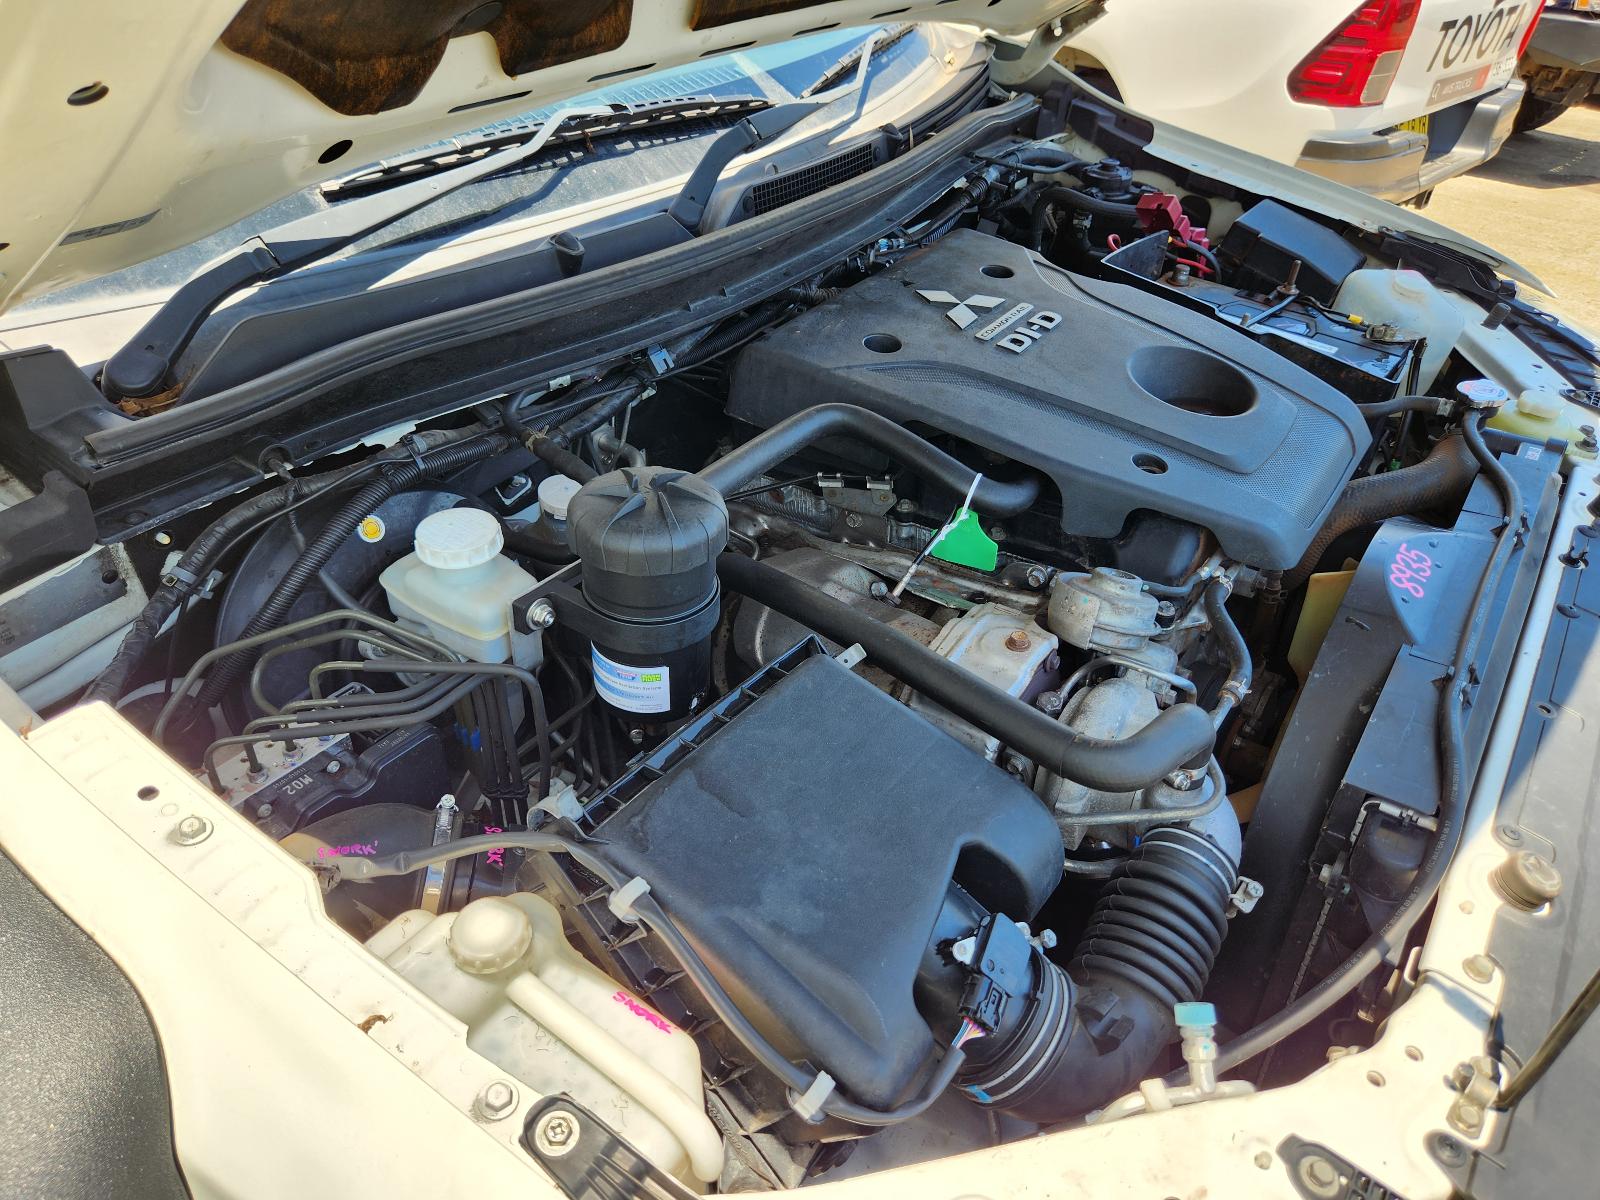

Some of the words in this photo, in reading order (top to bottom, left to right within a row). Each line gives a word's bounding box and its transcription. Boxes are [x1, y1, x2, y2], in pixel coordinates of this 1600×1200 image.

[1426, 3, 1527, 72] TOYOTA
[996, 311, 1063, 354] DI-D
[1390, 543, 1432, 599] 8935
[282, 774, 314, 796] M02
